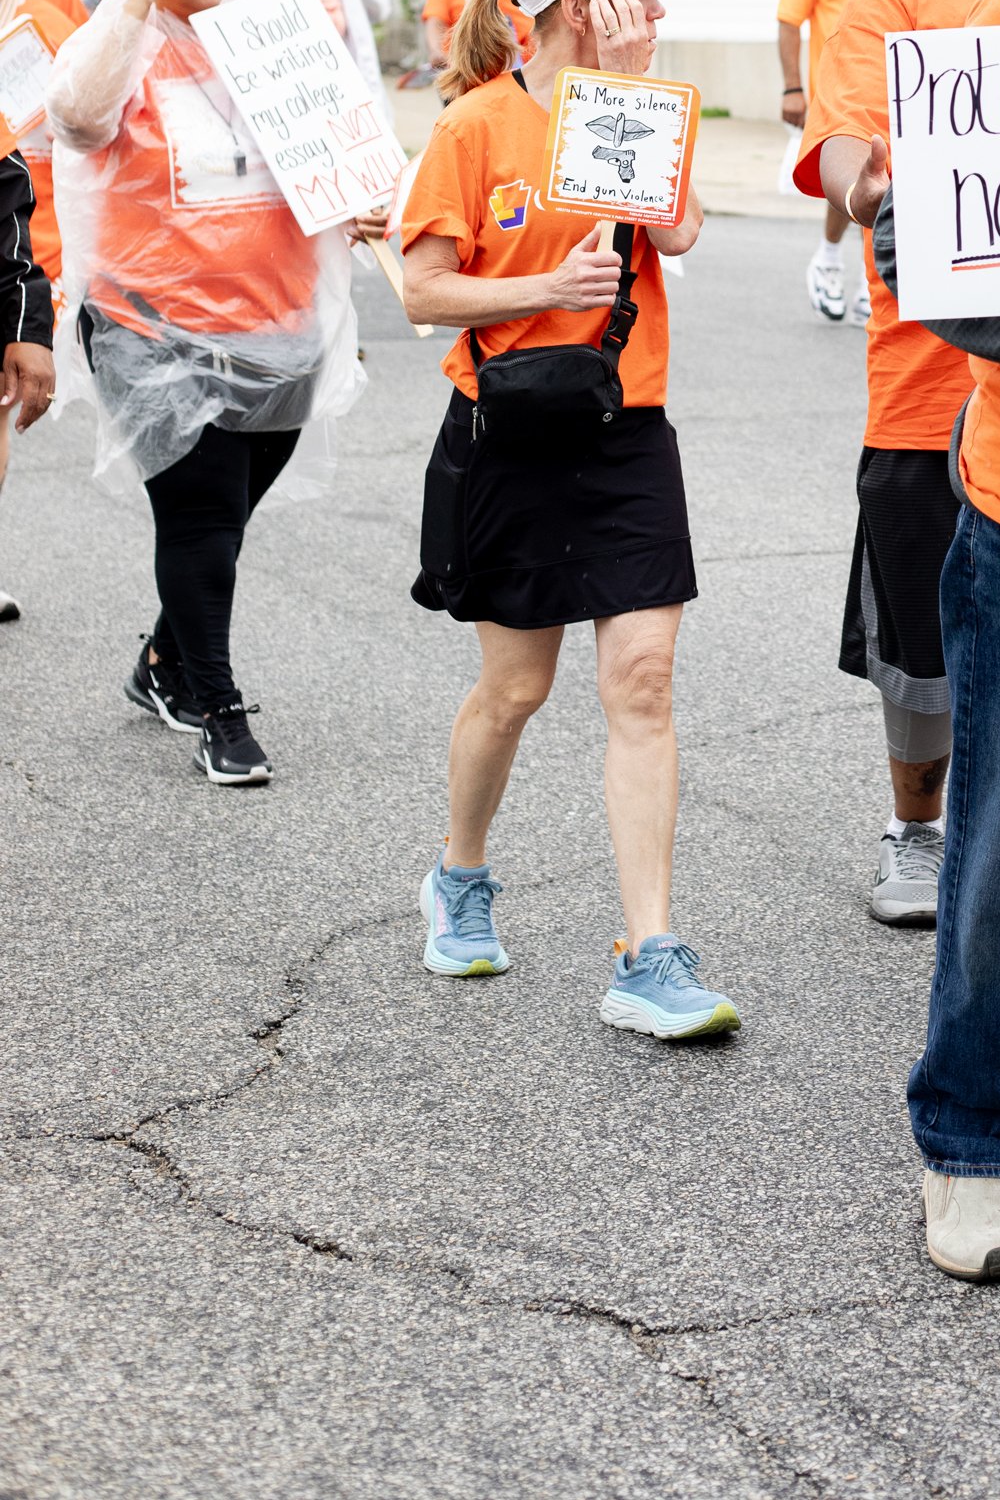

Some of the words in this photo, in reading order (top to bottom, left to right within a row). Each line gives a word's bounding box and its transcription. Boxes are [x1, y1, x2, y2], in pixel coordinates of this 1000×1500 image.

[214, 20, 235, 57] I
[225, 64, 258, 94] be
[263, 39, 339, 81] writing
[250, 106, 290, 140] my
[285, 82, 344, 116] college
[569, 84, 588, 101] No
[594, 87, 625, 107] More
[327, 101, 381, 148] NOT
[275, 137, 334, 171] essay
[295, 169, 347, 219] MY
[562, 177, 587, 193] End
[593, 186, 616, 199] gun
[619, 188, 664, 203] Violence
